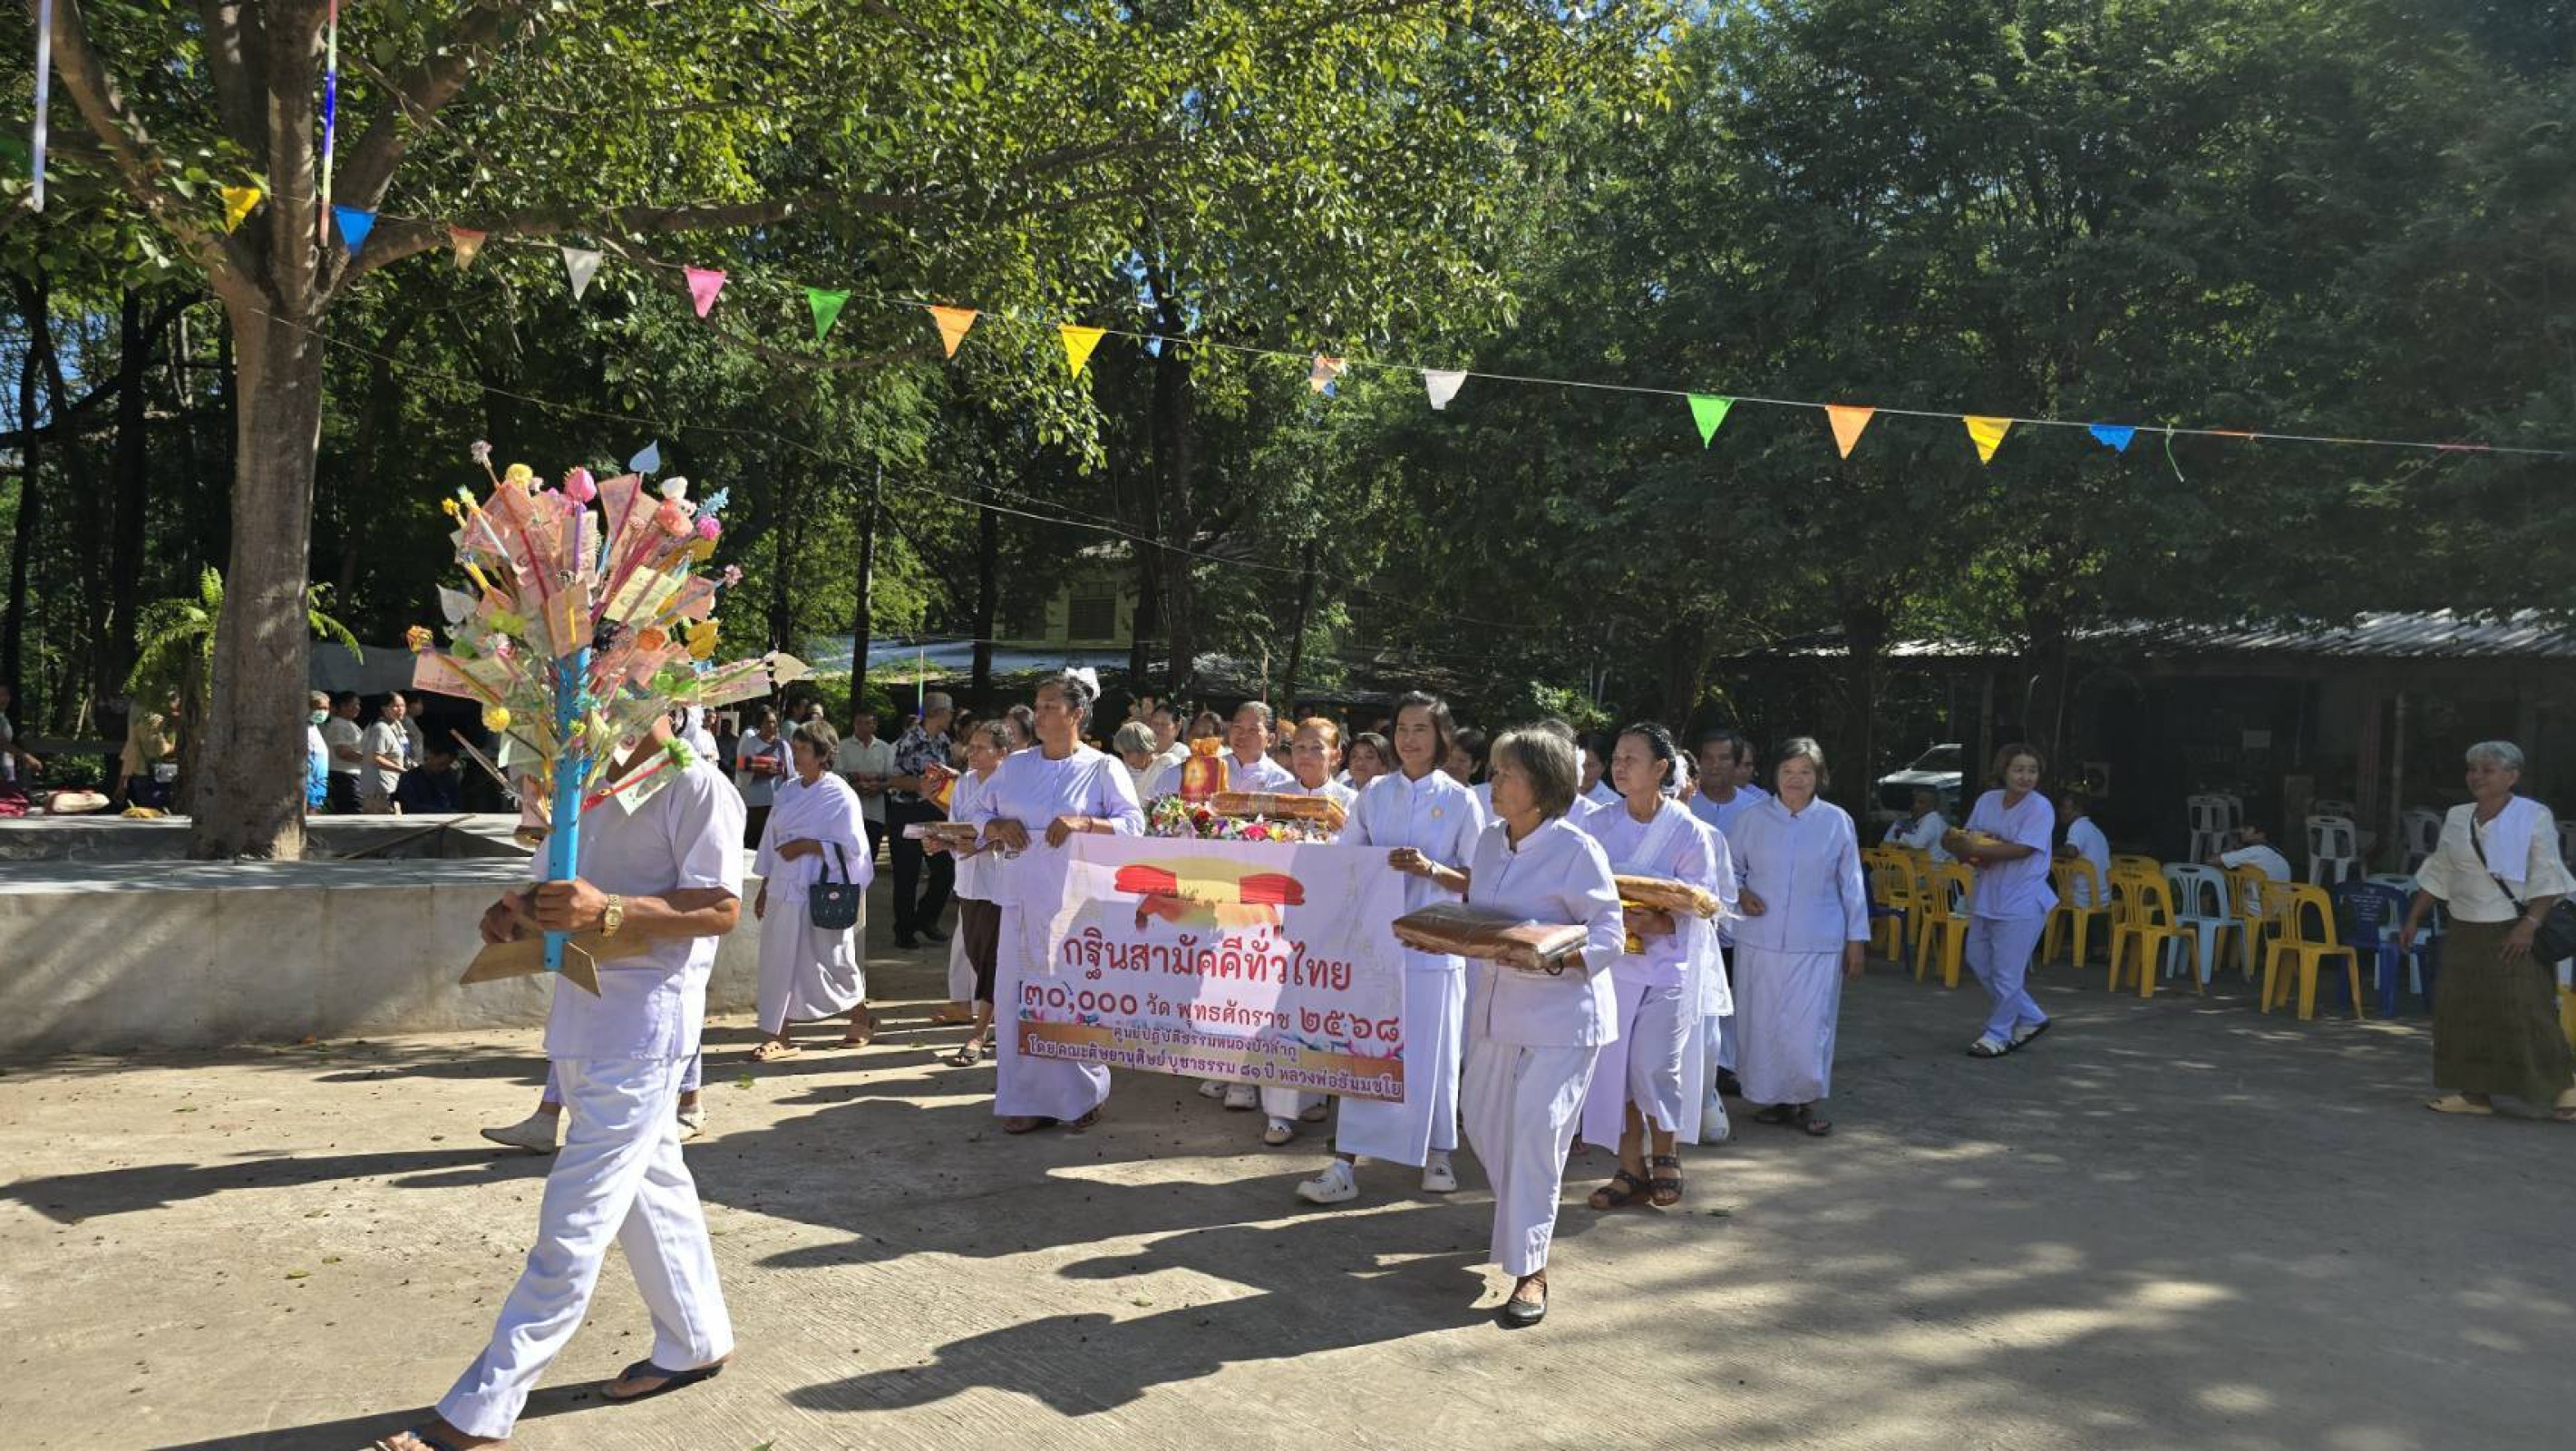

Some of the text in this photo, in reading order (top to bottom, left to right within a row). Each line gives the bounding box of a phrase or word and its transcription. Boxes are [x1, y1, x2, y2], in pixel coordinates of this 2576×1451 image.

[1064, 926, 1352, 991] กฐินสามัคคีทั่วไทย
[1025, 985, 1400, 1042] ๓๐,๐๐๐ วัด พุทธศักราช ๒๕๖๘
